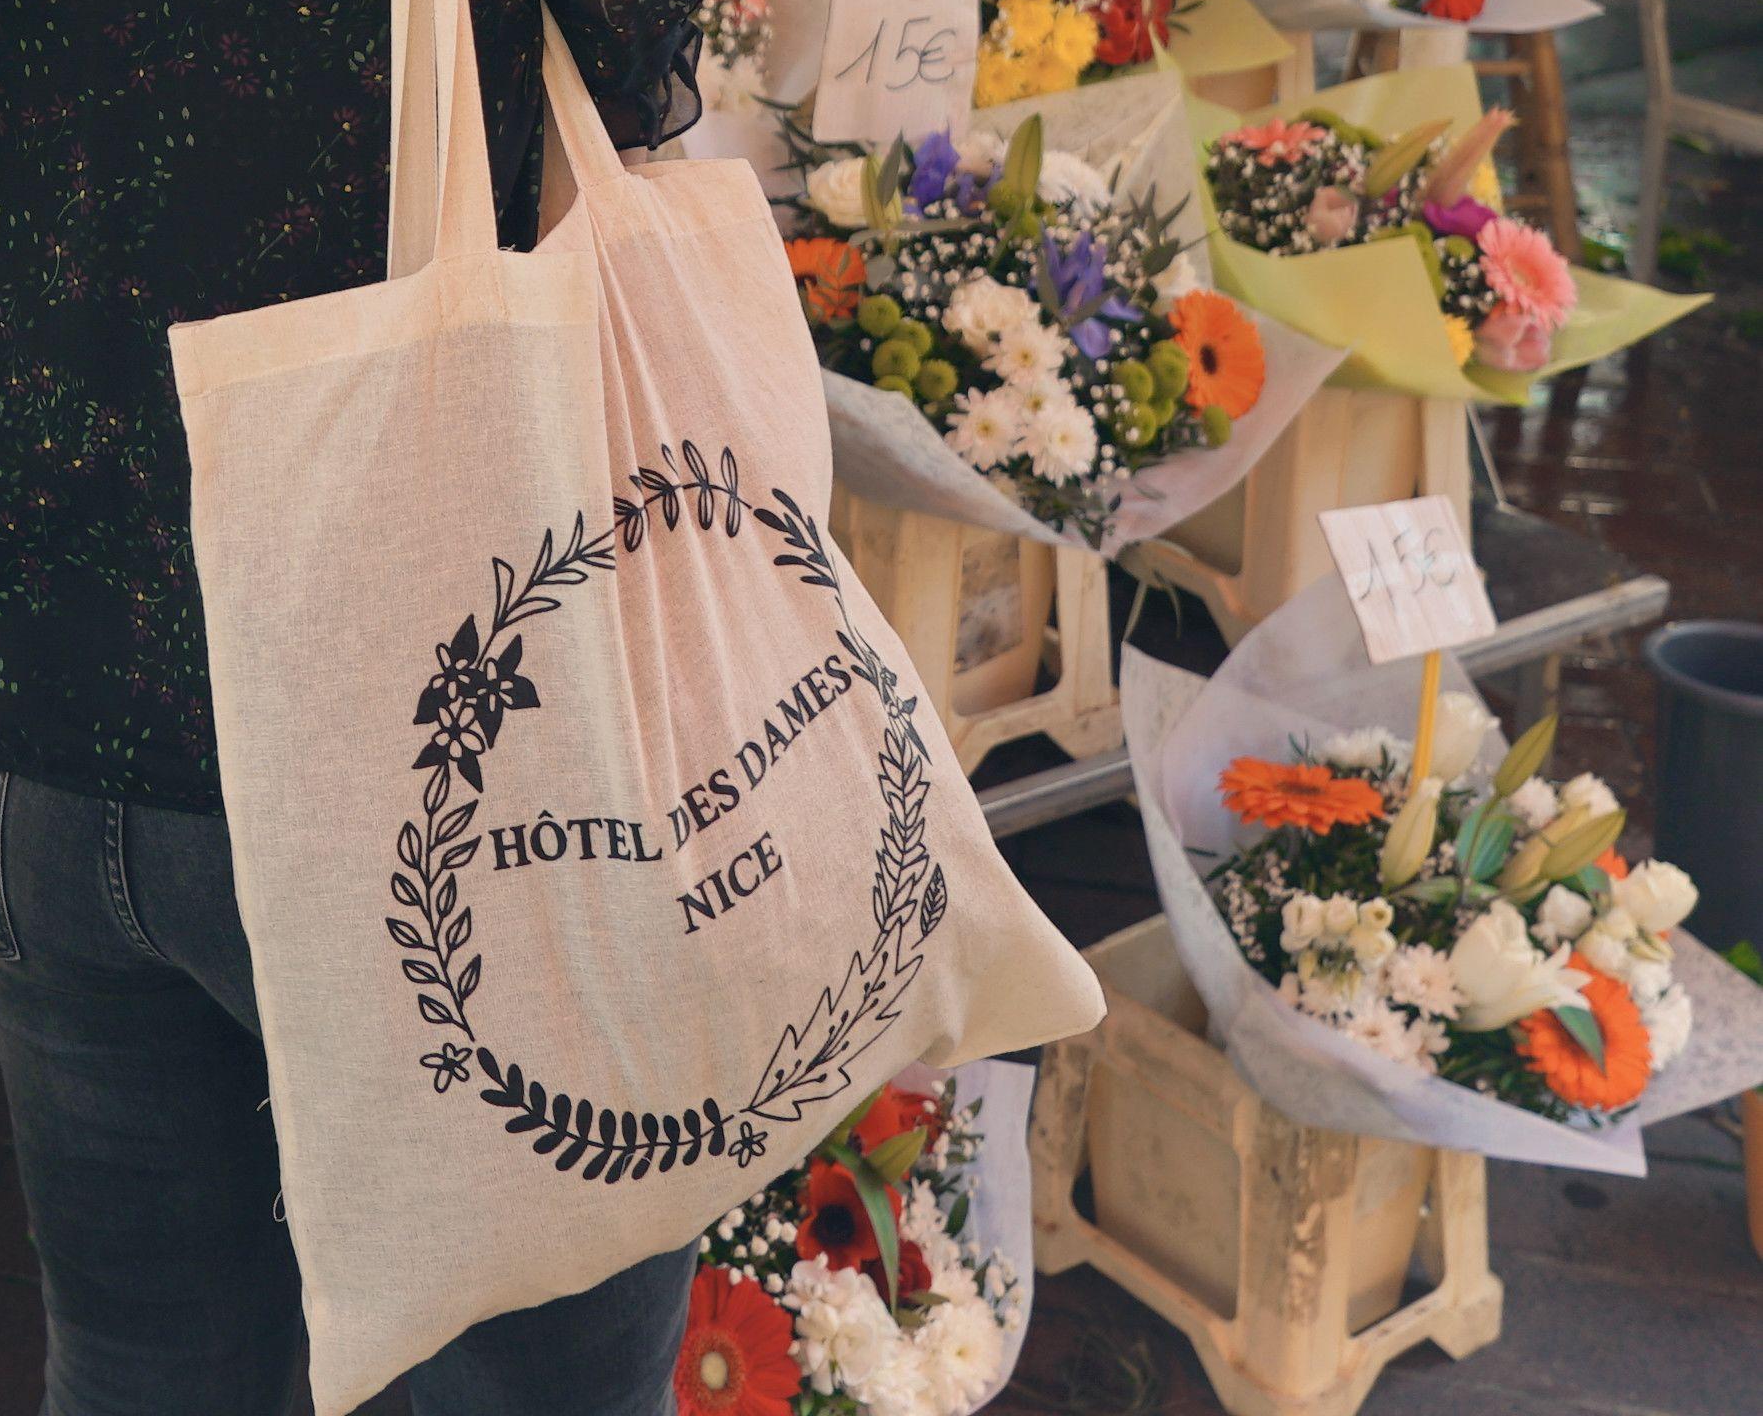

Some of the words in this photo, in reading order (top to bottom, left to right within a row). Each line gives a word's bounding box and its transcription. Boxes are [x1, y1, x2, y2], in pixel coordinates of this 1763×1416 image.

[835, 15, 957, 90] 15€
[488, 809, 663, 871] HÔTEL
[666, 768, 741, 853] DES
[734, 654, 853, 791] DAMES
[675, 830, 783, 935] NICE
